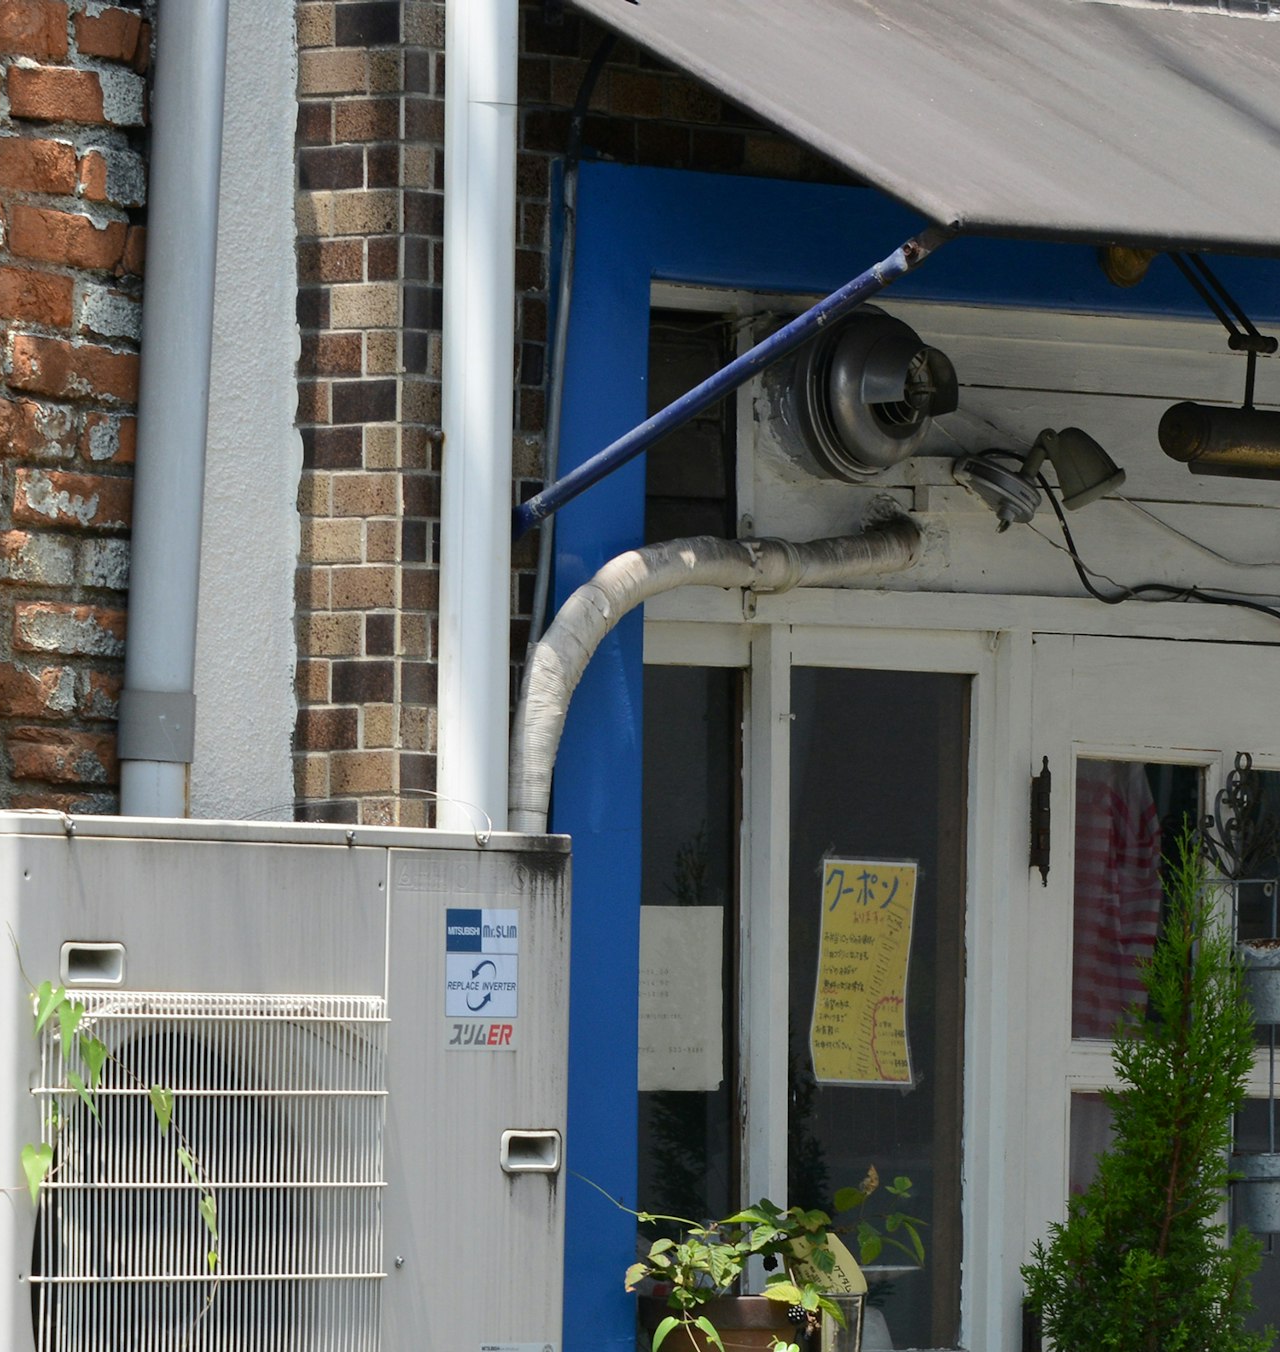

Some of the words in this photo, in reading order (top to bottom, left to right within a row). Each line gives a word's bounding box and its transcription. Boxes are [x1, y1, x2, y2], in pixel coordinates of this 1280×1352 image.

[826, 869, 899, 912] クーポン
[448, 926, 480, 936] MITSUBISHI
[483, 925, 517, 939] Mr.SLIM
[447, 981, 479, 991] REPLACE
[482, 981, 516, 992] INVERTER
[449, 1023, 513, 1046] スリムER
